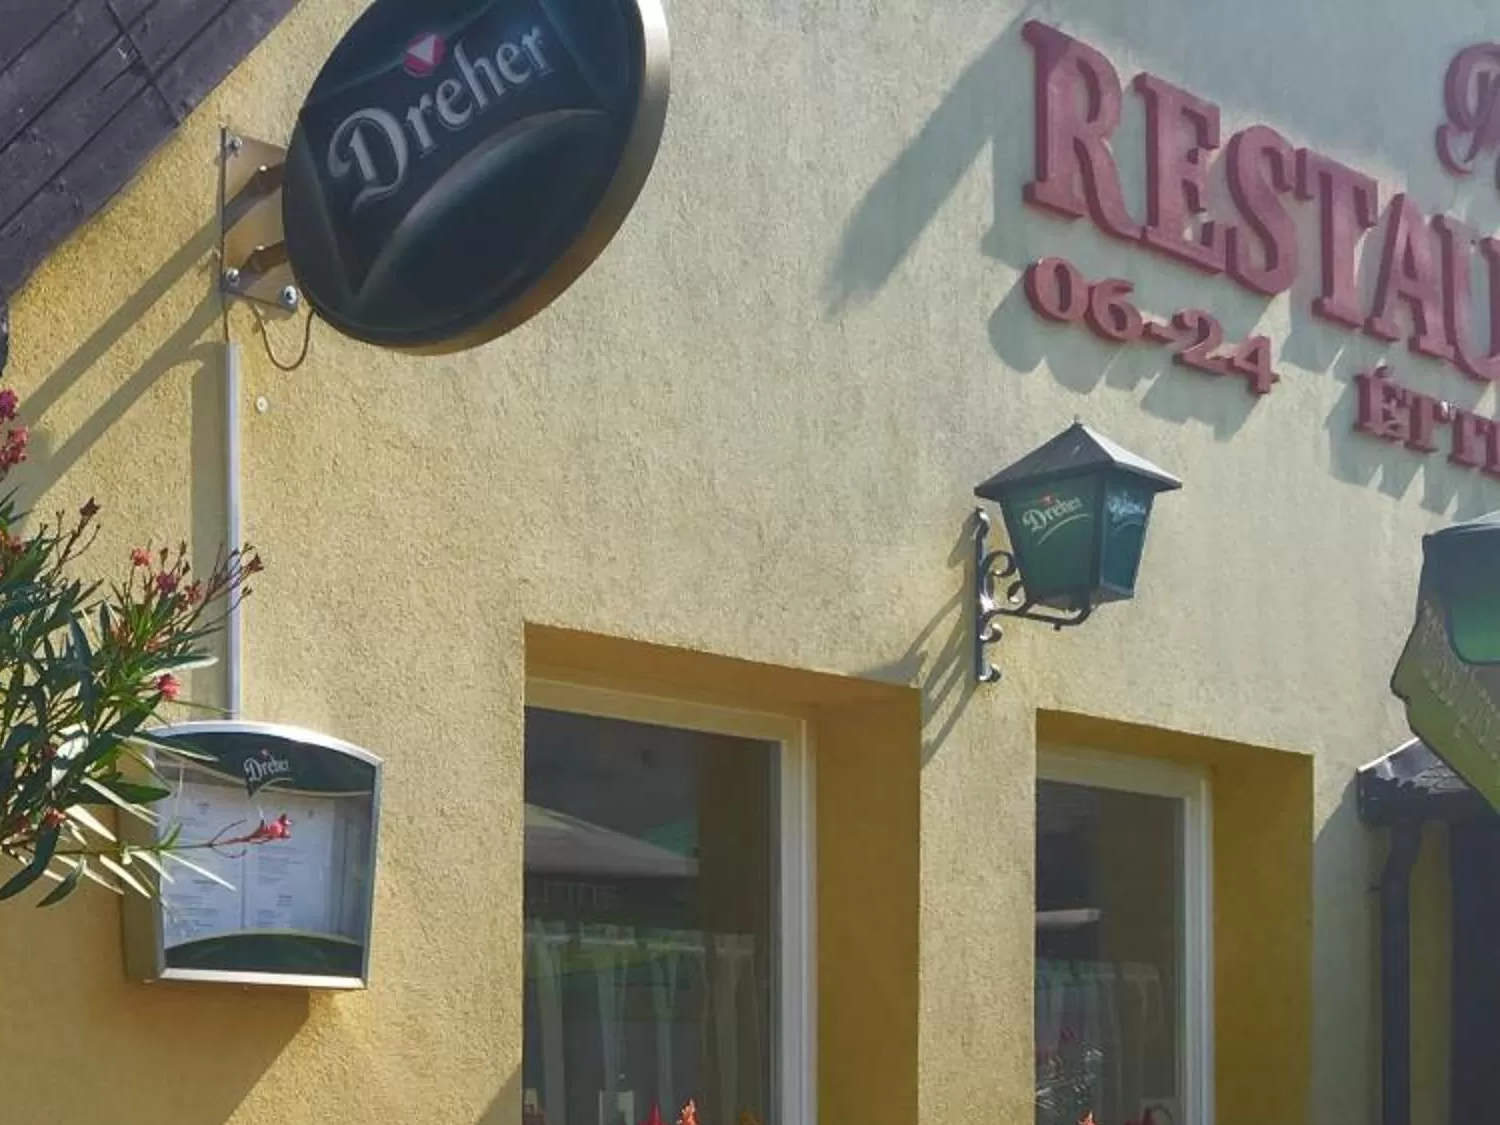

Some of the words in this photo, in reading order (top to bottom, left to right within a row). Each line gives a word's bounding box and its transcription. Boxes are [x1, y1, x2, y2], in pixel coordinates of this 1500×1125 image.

[327, 25, 555, 214] Dreher
[1021, 19, 1500, 382] RESTAU
[1025, 256, 1281, 395] 06-24
[1022, 495, 1083, 532] Dreher
